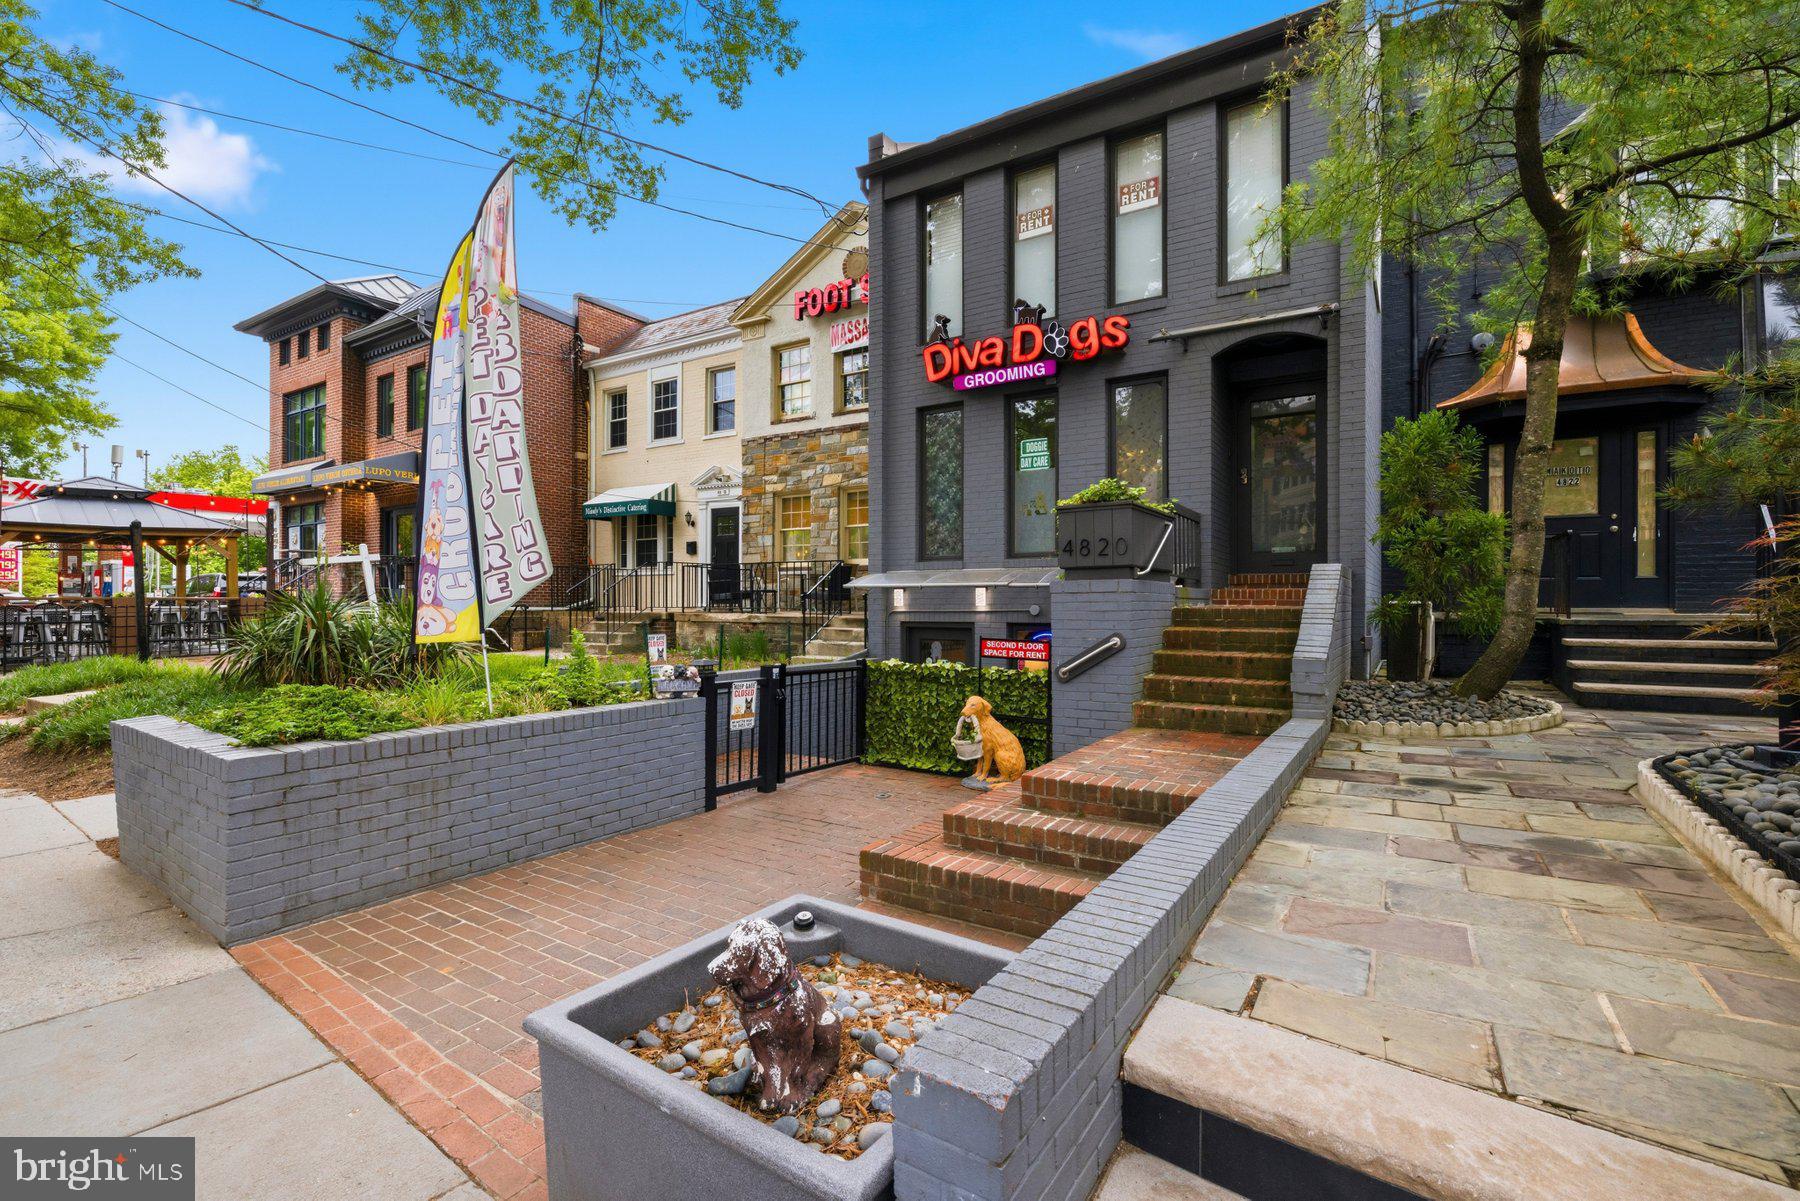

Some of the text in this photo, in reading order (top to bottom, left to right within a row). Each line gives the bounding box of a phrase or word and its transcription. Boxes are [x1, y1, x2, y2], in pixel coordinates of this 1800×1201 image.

[1130, 181, 1147, 192] FOR
[1121, 187, 1156, 206] RENT
[1027, 209, 1042, 220] FOR
[1020, 215, 1050, 233] RENT
[794, 278, 854, 321] FOOT
[831, 318, 869, 347] MASSA
[923, 335, 1006, 383] Diva
[963, 362, 1046, 389] GROOMING
[430, 354, 454, 471] PET
[1026, 440, 1048, 453] DOGGIE
[1020, 456, 1048, 468] DAY CARE
[366, 467, 420, 481] LUPO VER
[1, 480, 47, 500] EXX
[603, 504, 626, 514] Distinctive
[627, 503, 648, 513] Catering
[1062, 537, 1129, 557] 4820
[986, 640, 1044, 650] SECOND FLOOR
[984, 649, 1008, 657] SPACE
[1026, 652, 1047, 660] RENT
[734, 689, 755, 698] CLOSED
